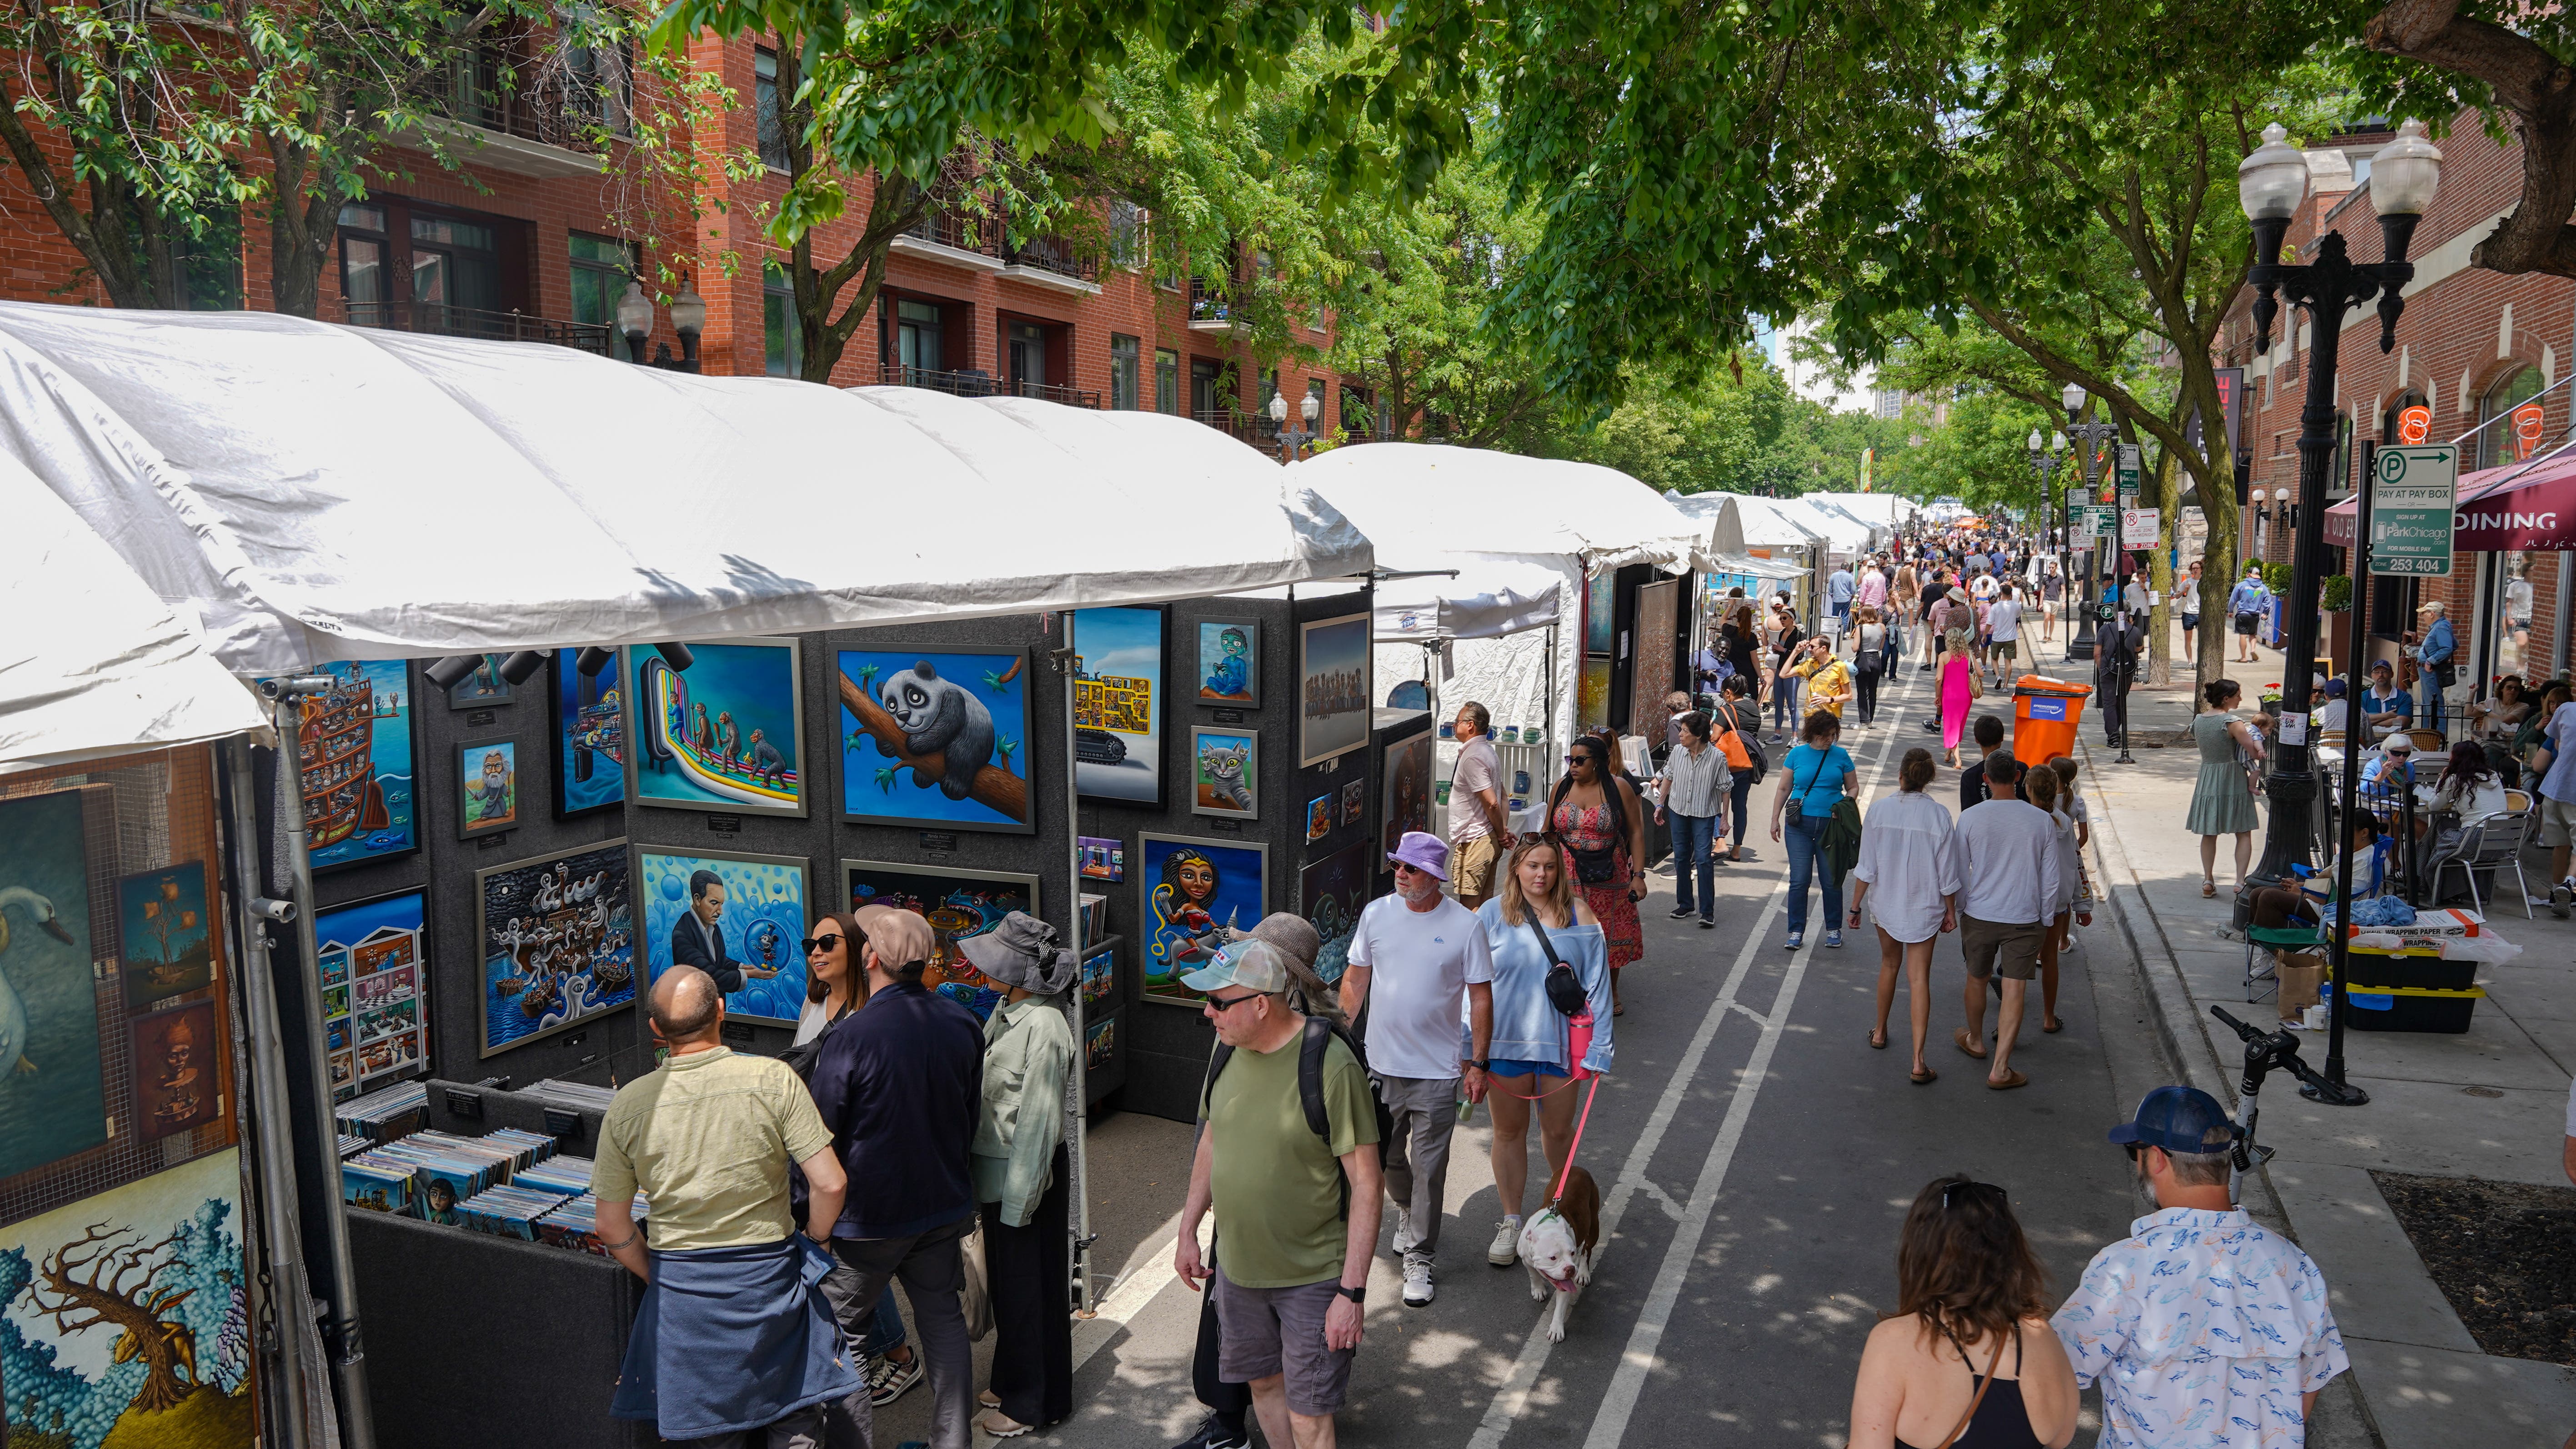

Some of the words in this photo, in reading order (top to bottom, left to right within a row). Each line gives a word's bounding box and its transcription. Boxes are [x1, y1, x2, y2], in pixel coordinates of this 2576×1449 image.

[2395, 490, 2407, 498] AT
[2409, 490, 2426, 498] PAY
[2428, 490, 2449, 498] BOX
[2454, 512, 2556, 530] DINING
[2387, 526, 2447, 540] ParkChicago
[2390, 558, 2413, 571] 253
[2416, 560, 2439, 572] 404
